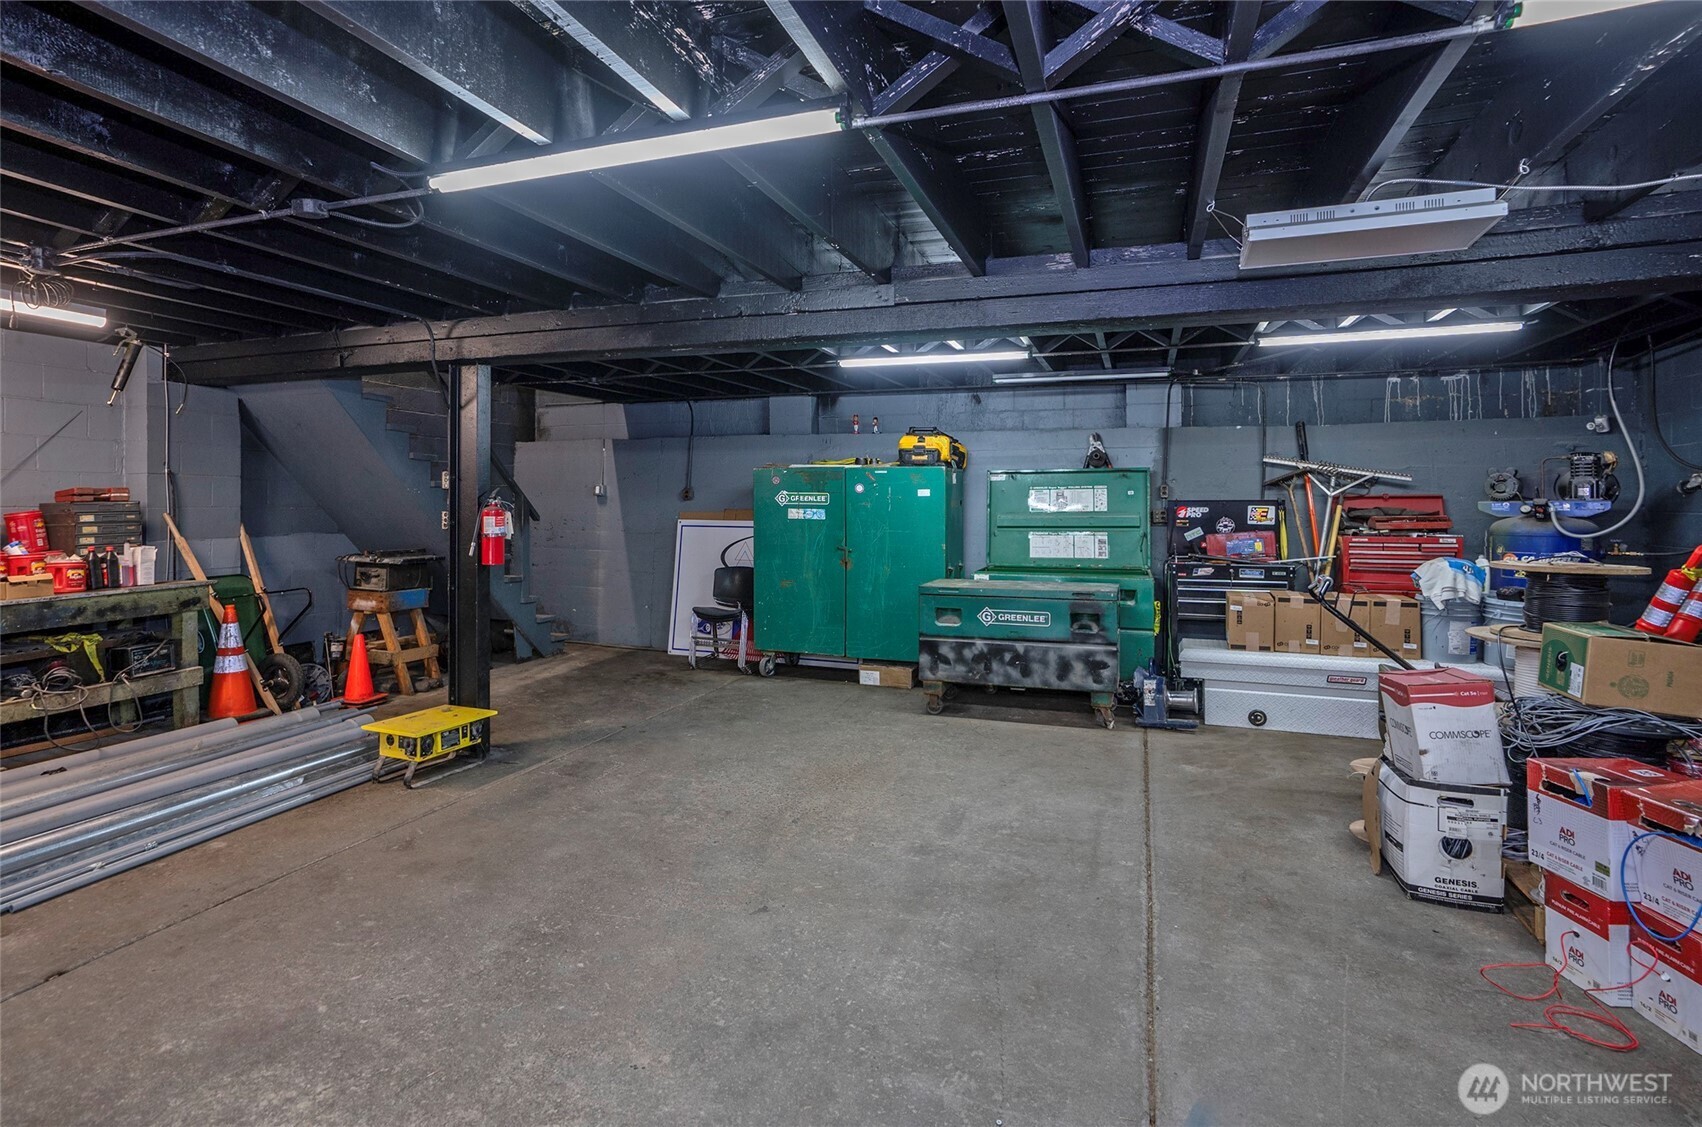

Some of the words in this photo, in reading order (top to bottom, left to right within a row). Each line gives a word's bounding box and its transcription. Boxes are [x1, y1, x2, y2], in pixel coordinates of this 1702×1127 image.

[998, 613, 1046, 623] GREENLEE
[1429, 729, 1491, 740] COMMSCOPE
[1559, 826, 1575, 839] ADI
[1559, 834, 1576, 846] PRO
[1434, 876, 1478, 889] GENESIS
[1673, 868, 1692, 883] ADI
[1673, 876, 1694, 891] PRO
[1417, 886, 1447, 897] GENESIS
[1448, 892, 1473, 901] SERIES
[1568, 952, 1585, 968] PRO
[1569, 946, 1584, 960] ADI
[1658, 990, 1677, 1006] ADI
[1658, 996, 1678, 1015] PRO
